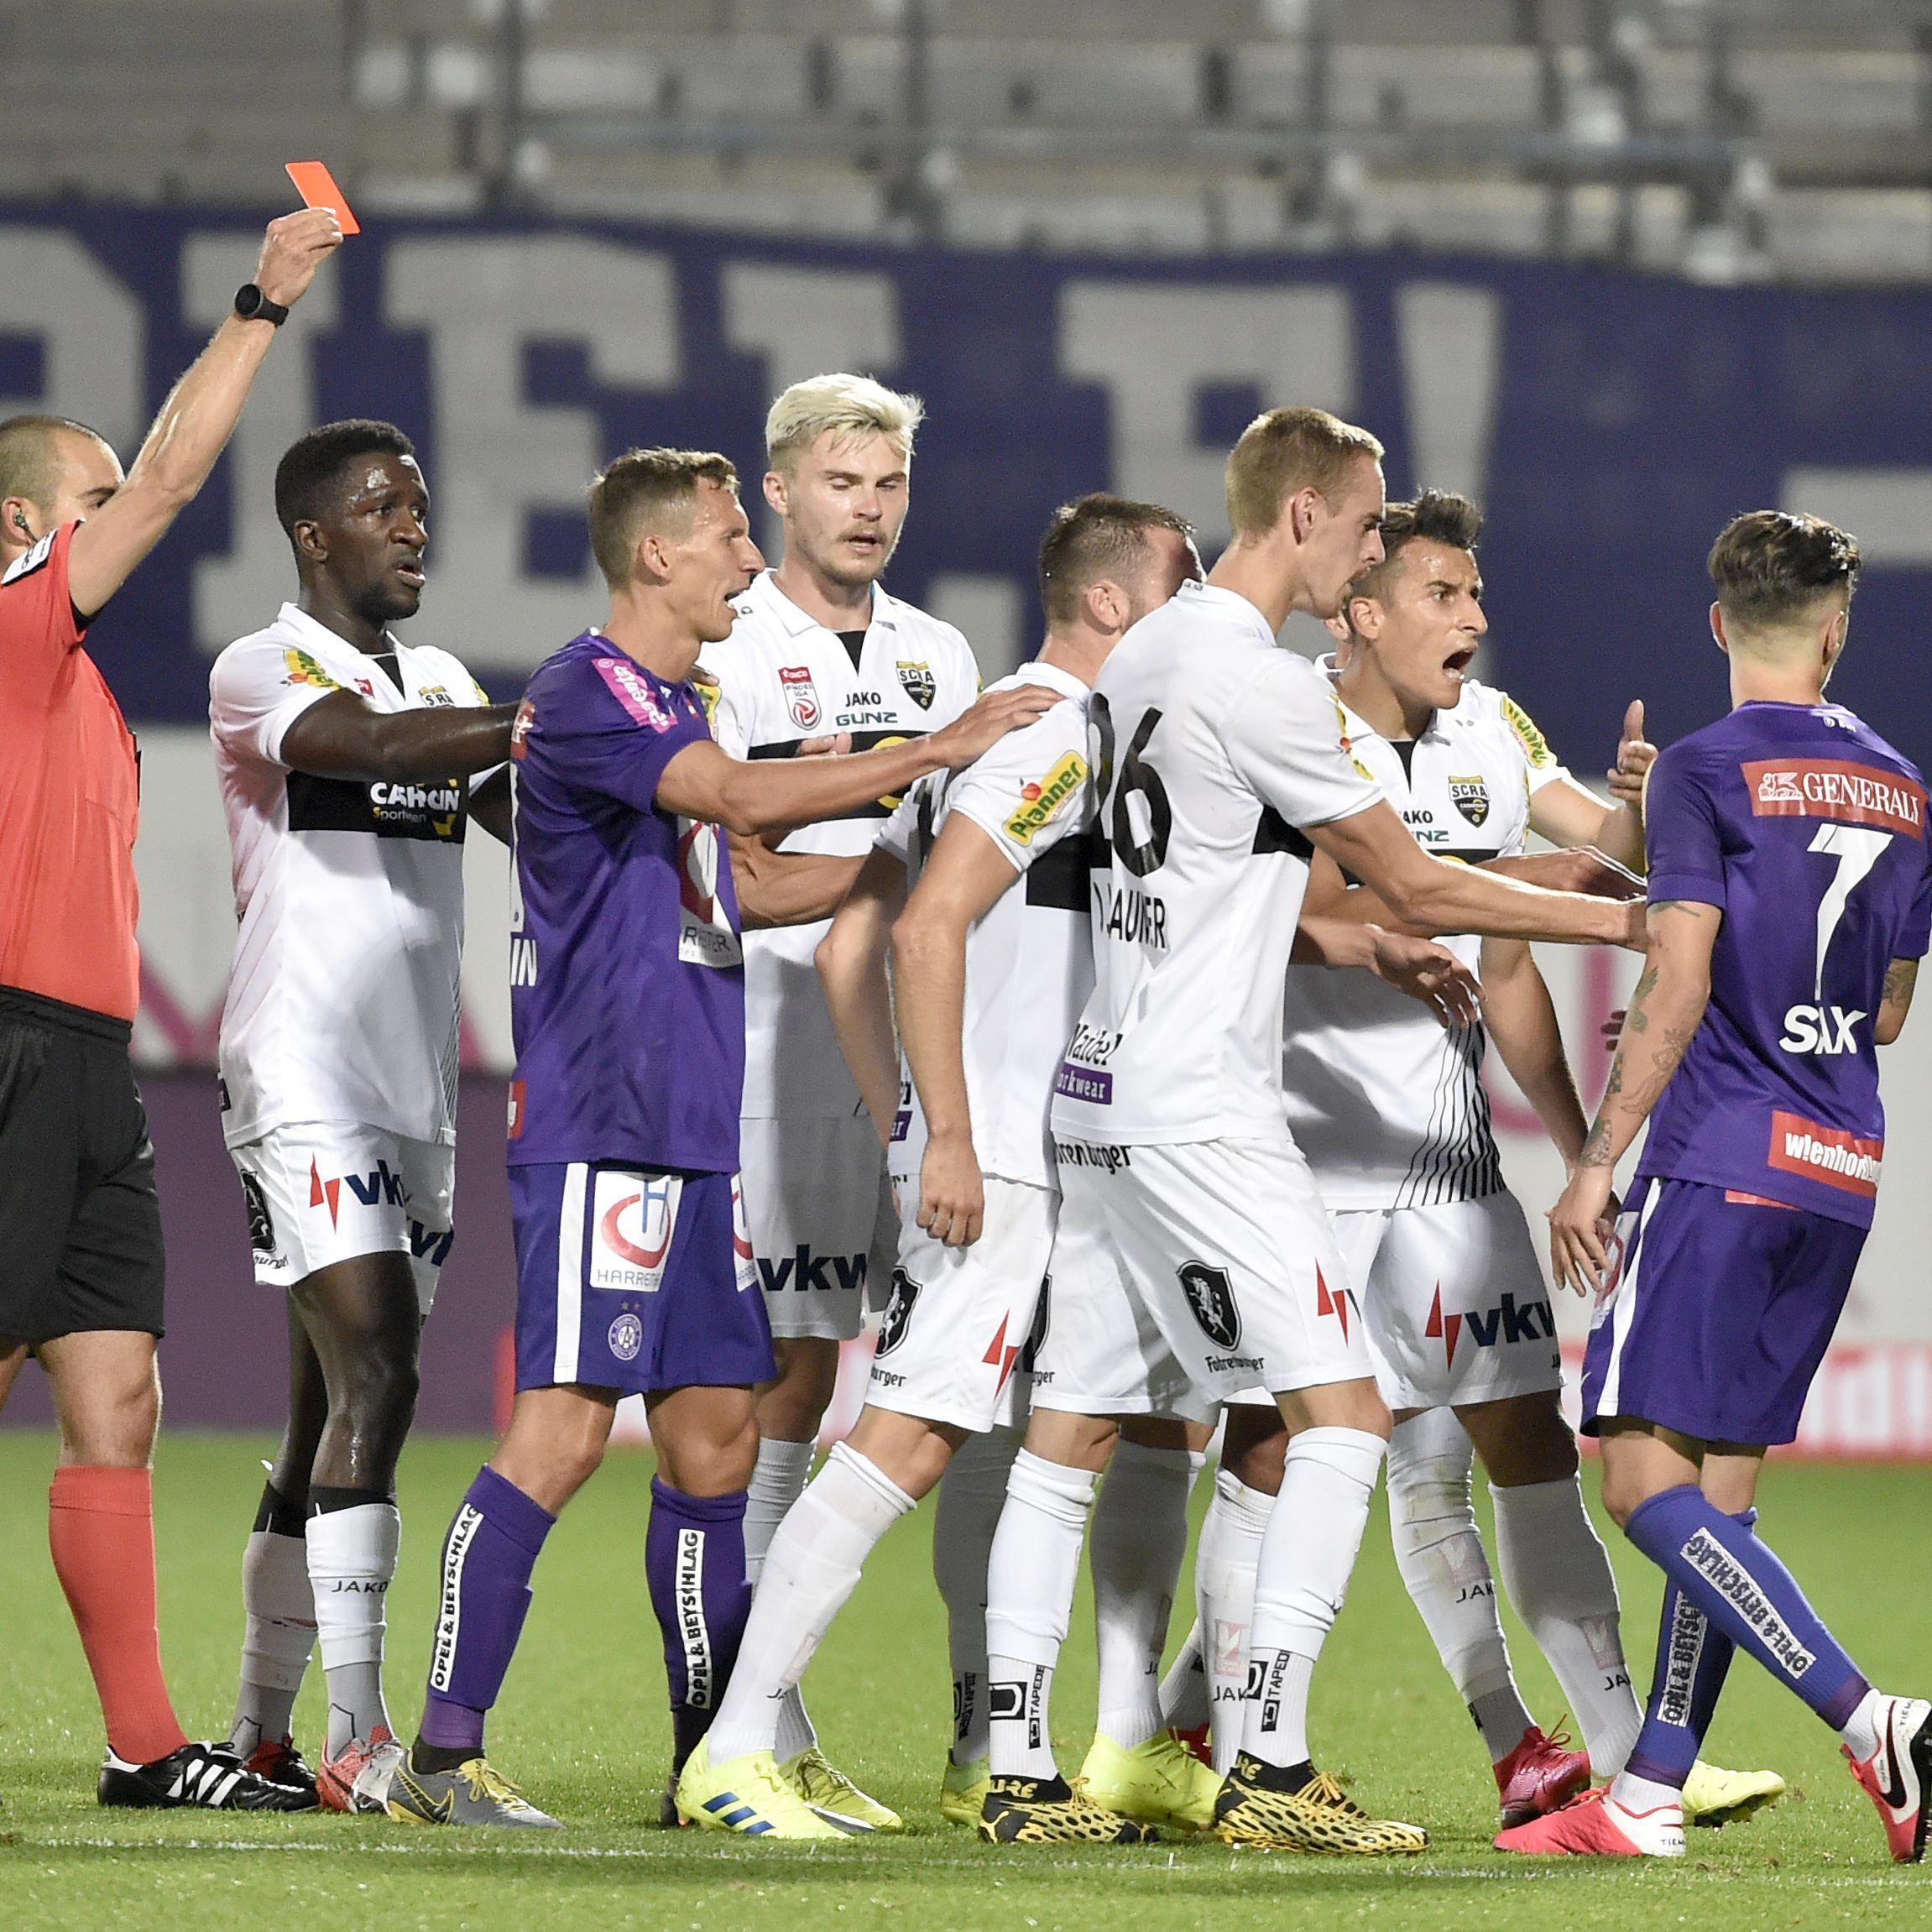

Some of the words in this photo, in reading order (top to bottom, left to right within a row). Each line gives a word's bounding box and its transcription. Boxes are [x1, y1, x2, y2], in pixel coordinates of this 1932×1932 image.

[835, 712, 898, 726] GUNZ
[845, 692, 881, 707] JAKO
[1452, 785, 1487, 798] SCRA
[1803, 772, 1919, 825] GENERALI
[1402, 810, 1433, 824] AKO
[1807, 822, 1894, 1001] 7
[1687, 1535, 1770, 1625] BEYSCHLAG
[442, 1619, 455, 1636] &
[435, 1637, 452, 1687] OPEL
[1773, 1632, 1808, 1672] OPEL
[691, 1654, 707, 1707] OPEL
